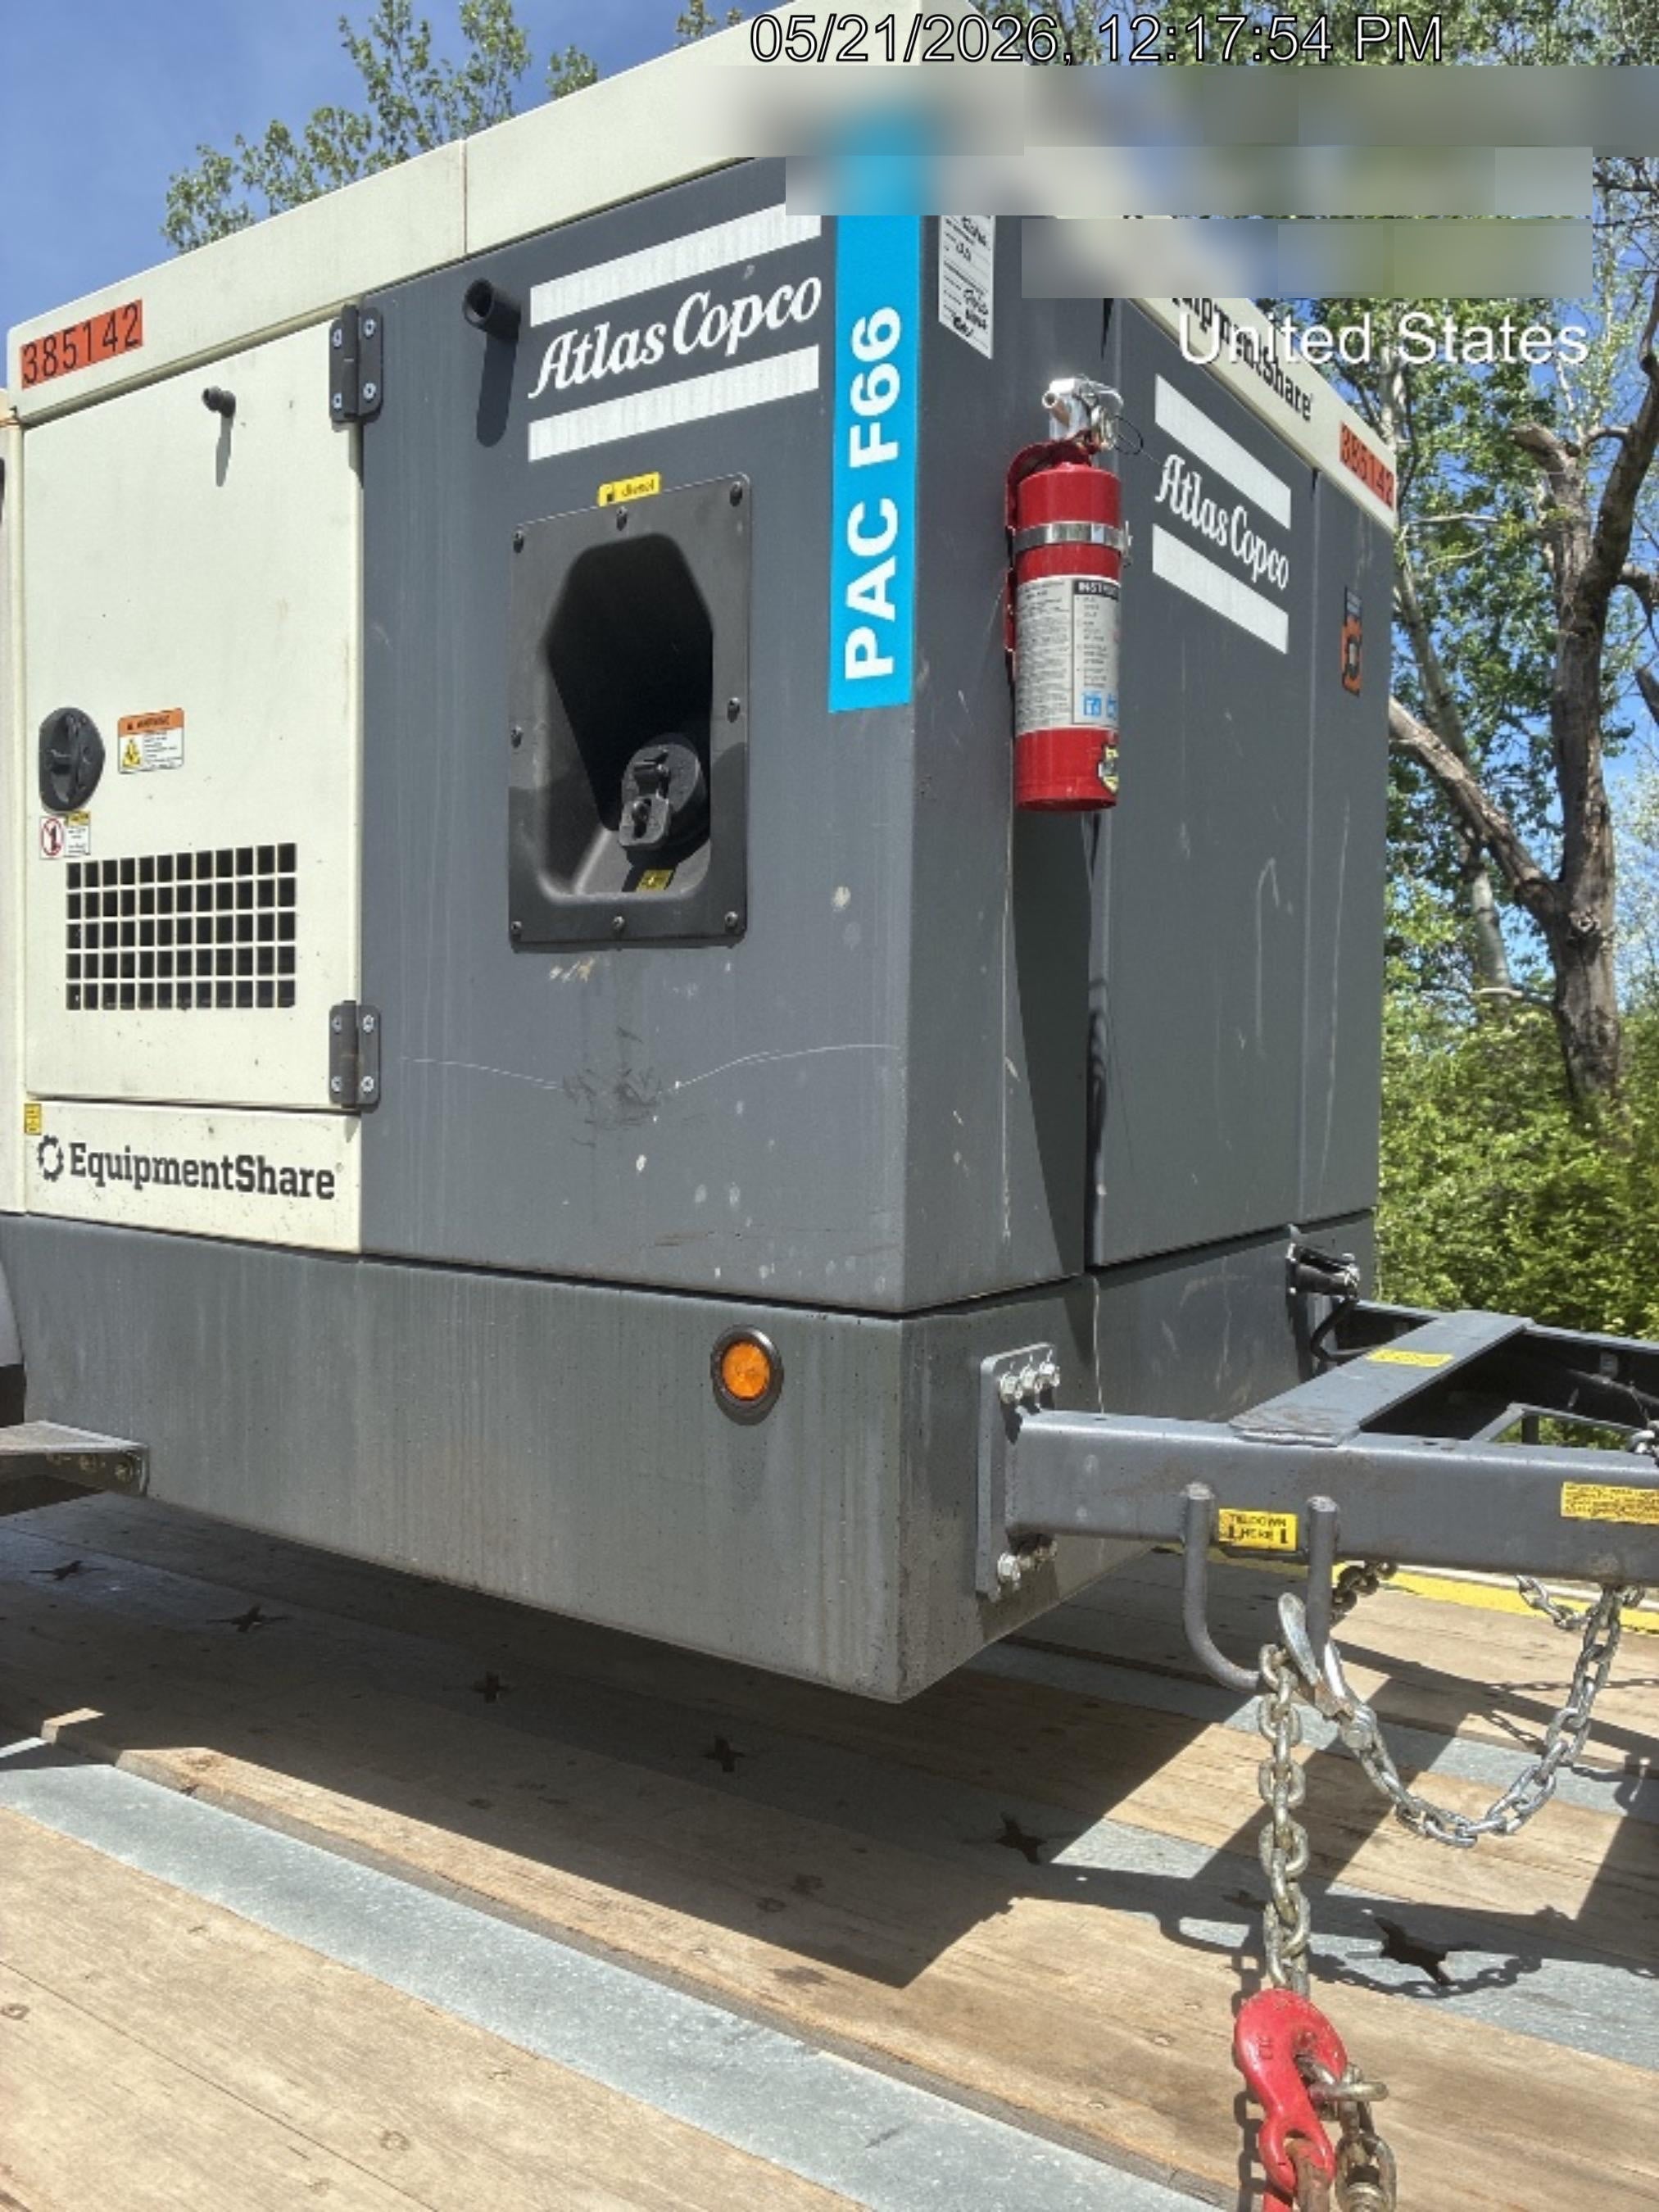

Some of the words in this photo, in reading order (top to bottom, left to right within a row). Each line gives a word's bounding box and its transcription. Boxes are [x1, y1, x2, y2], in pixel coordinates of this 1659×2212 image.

[23, 302, 139, 384] 385142
[528, 321, 668, 400] Atlas
[673, 276, 823, 358] Copco
[849, 306, 902, 468] F66
[1154, 454, 1229, 547] Atlas
[1231, 505, 1290, 591] Copco
[1340, 422, 1394, 509] 385142
[845, 497, 899, 679] PAC
[68, 1142, 335, 1200] EquipmentShare
